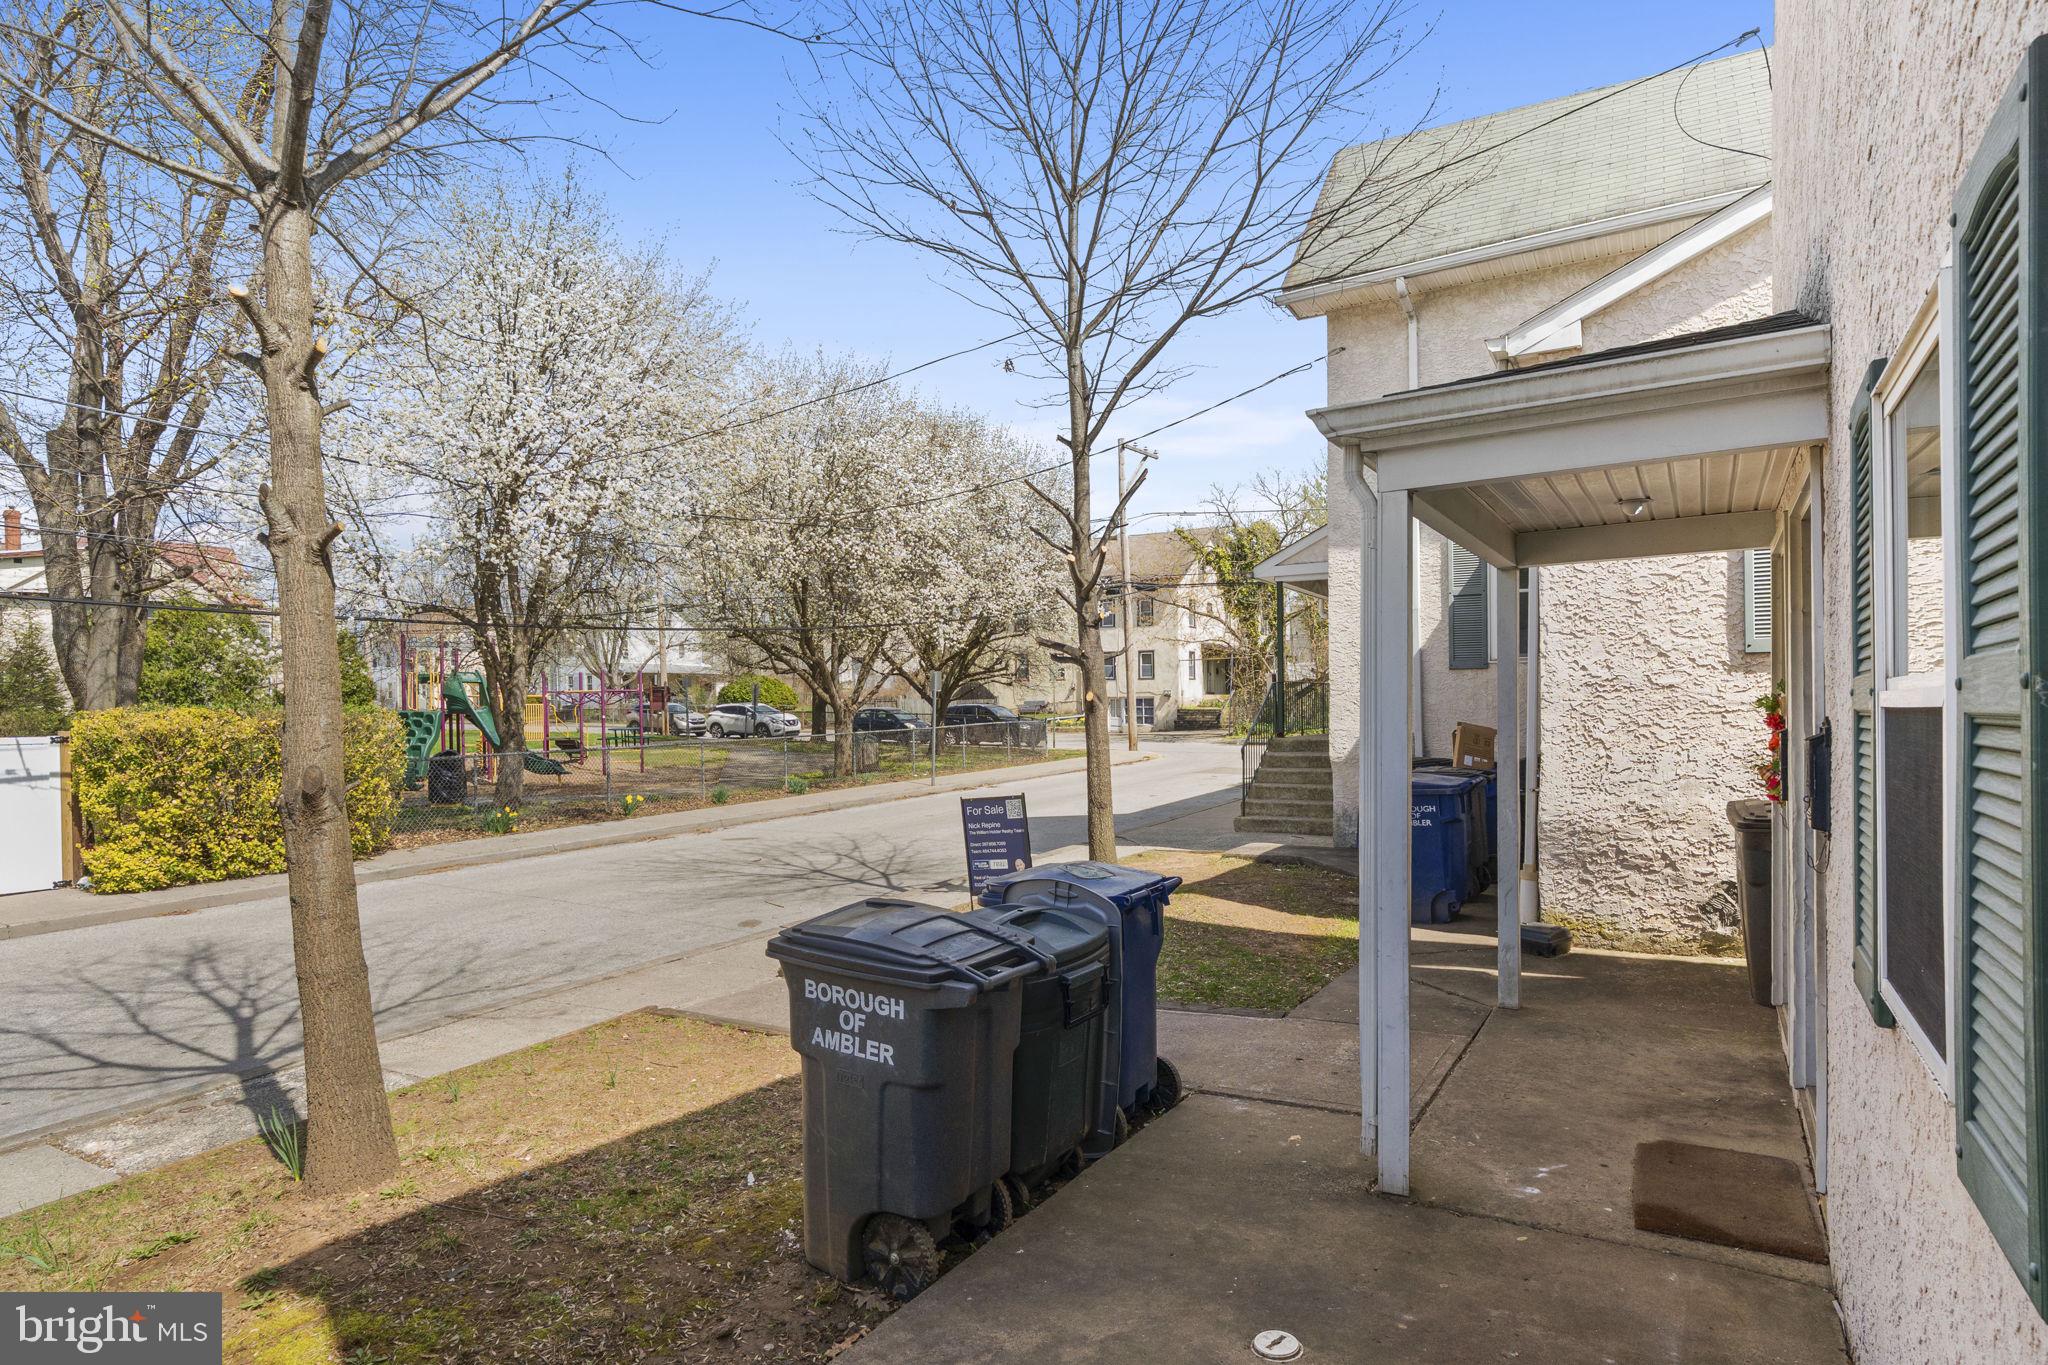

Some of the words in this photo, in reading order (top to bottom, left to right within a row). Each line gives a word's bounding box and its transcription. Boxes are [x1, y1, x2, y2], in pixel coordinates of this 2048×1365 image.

[967, 806, 982, 816] For
[984, 804, 1004, 815] Sale
[1411, 805, 1436, 813] OUGH
[1412, 819, 1432, 827] BLER
[805, 979, 904, 1020] BOROUGH
[839, 1010, 866, 1033] OF
[811, 1026, 895, 1066] AMBLER
